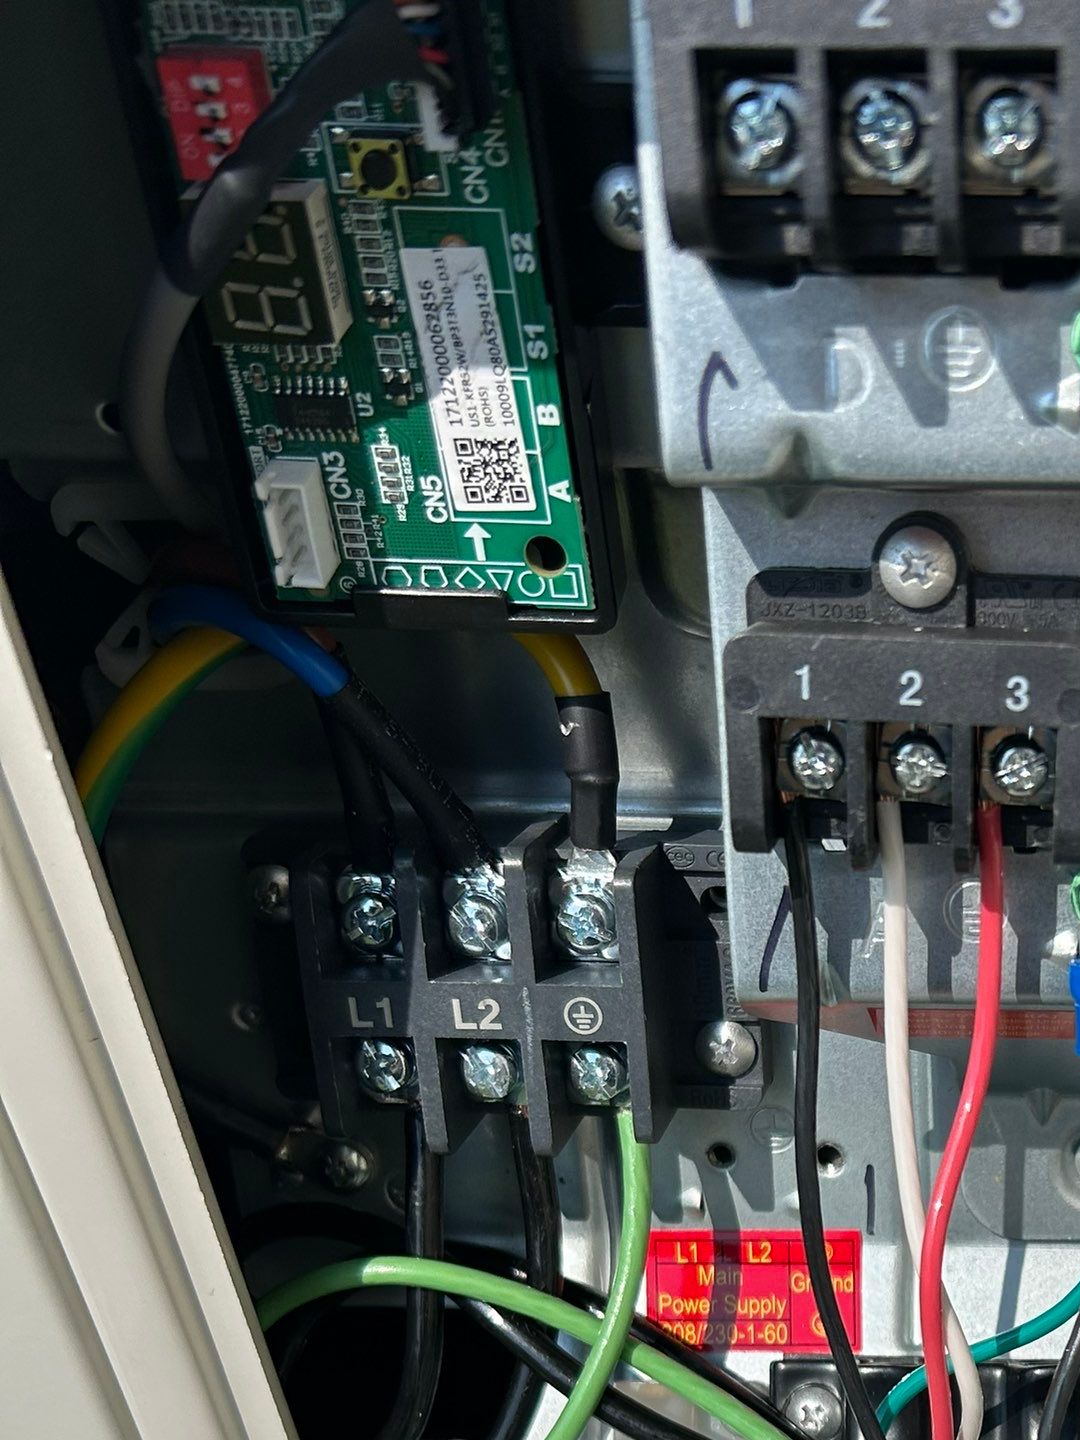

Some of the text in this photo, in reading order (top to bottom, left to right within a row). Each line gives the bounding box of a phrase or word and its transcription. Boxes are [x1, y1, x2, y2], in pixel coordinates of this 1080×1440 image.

[460, 146, 490, 204] CN4
[510, 231, 537, 274] S2
[524, 323, 549, 361] S1
[356, 391, 374, 417] U2
[478, 386, 497, 427] (ROHS)
[536, 403, 561, 427] B
[322, 451, 352, 498] CN3
[419, 475, 449, 524] CN5
[549, 479, 572, 501] A
[794, 664, 1030, 712] 1 2 3
[349, 998, 394, 1028] L1
[451, 1000, 501, 1030] L2
[676, 1241, 698, 1263] L1
[747, 1241, 772, 1263] L2
[698, 1265, 744, 1286] Main
[791, 1270, 854, 1293] Grnd
[658, 1293, 788, 1320] Power Supply
